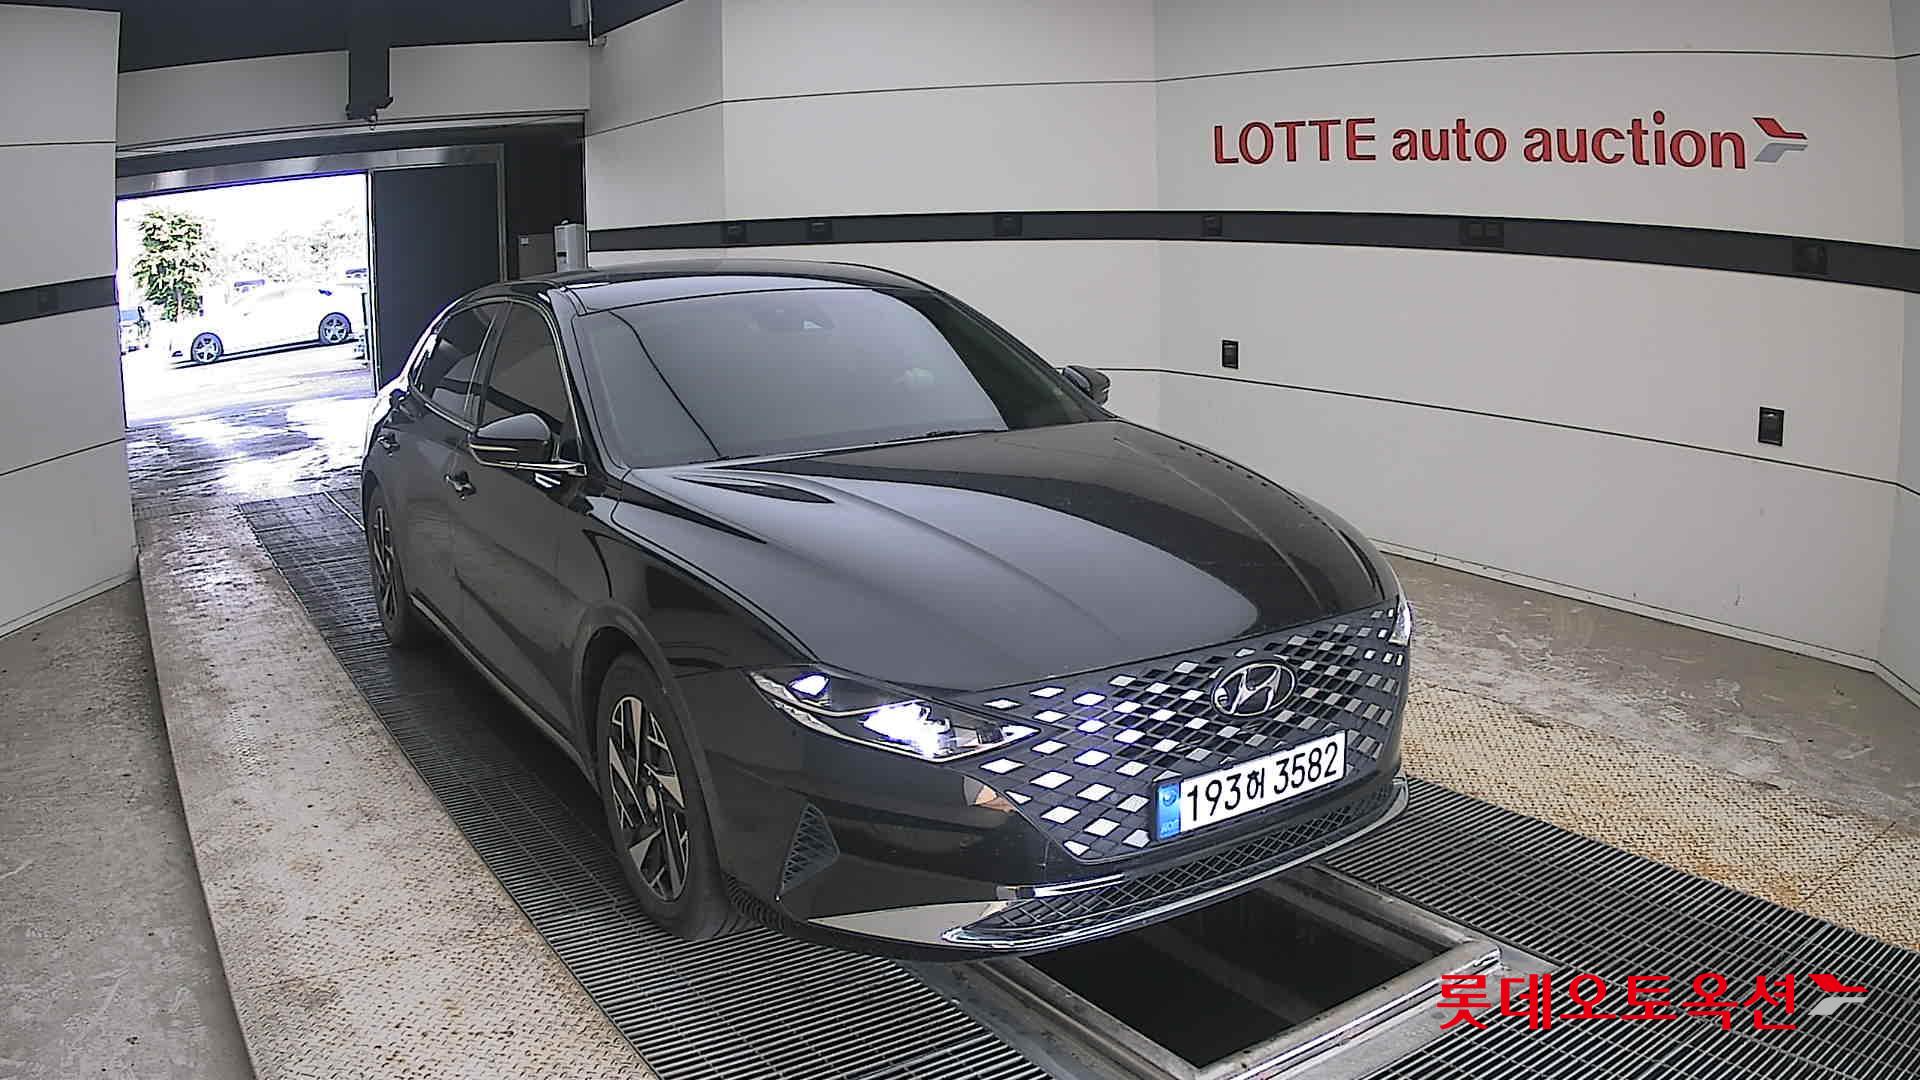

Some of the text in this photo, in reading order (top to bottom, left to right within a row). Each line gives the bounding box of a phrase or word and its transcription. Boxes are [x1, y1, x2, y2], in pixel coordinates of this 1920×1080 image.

[1215, 111, 1746, 169] LOTTE auto auction
[1187, 741, 1338, 821] 193허 3582
